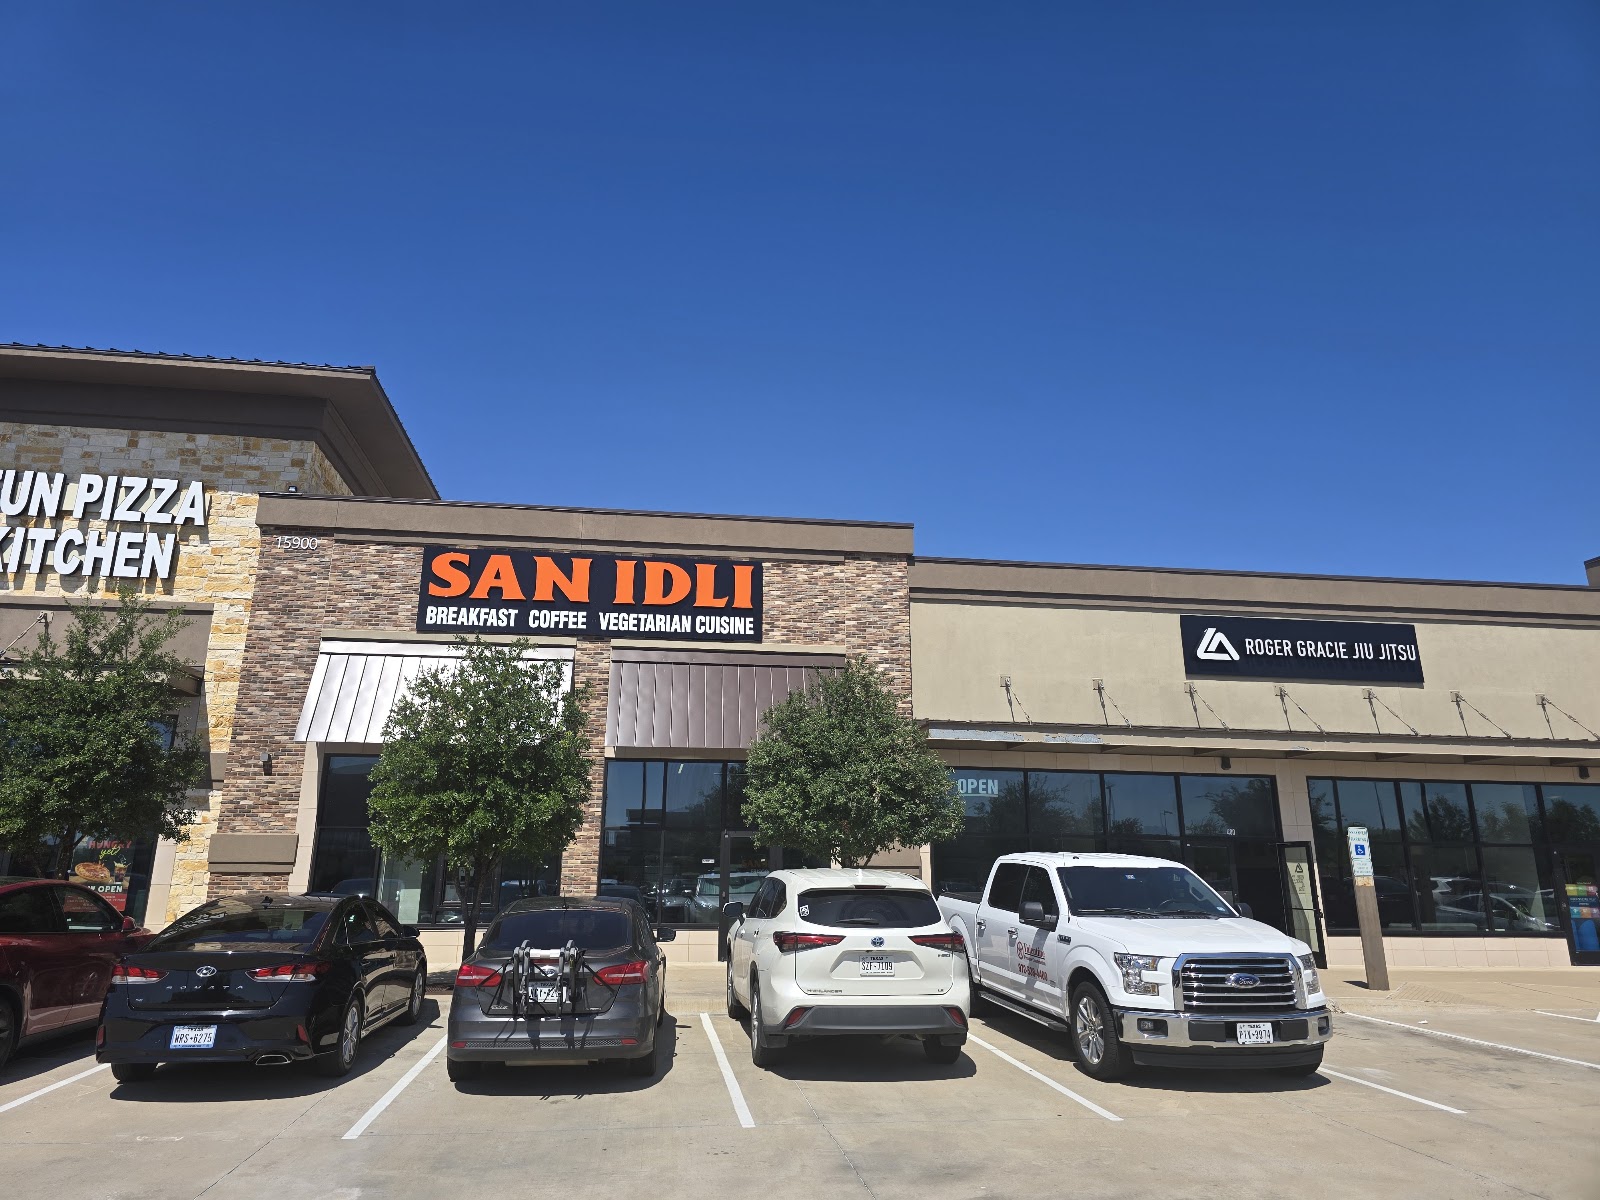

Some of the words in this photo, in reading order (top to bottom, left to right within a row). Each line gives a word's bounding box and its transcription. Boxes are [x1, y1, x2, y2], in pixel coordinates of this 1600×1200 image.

[0, 469, 66, 518] UN
[73, 473, 206, 526] PIZZA
[275, 535, 318, 550] 15900
[428, 551, 593, 603] SAN
[612, 559, 755, 609] IDLI
[425, 605, 519, 627] BREAKFAST
[528, 609, 587, 630] COFFEE
[599, 611, 692, 633] VEGETARIAN
[695, 615, 755, 636] CUISINE
[1244, 638, 1294, 658] ROGER
[1296, 640, 1349, 659] GRACIE
[1352, 642, 1374, 660] JIU
[1378, 643, 1417, 662] JITSU
[957, 778, 999, 795] OPEN
[97, 885, 123, 893] OPEN
